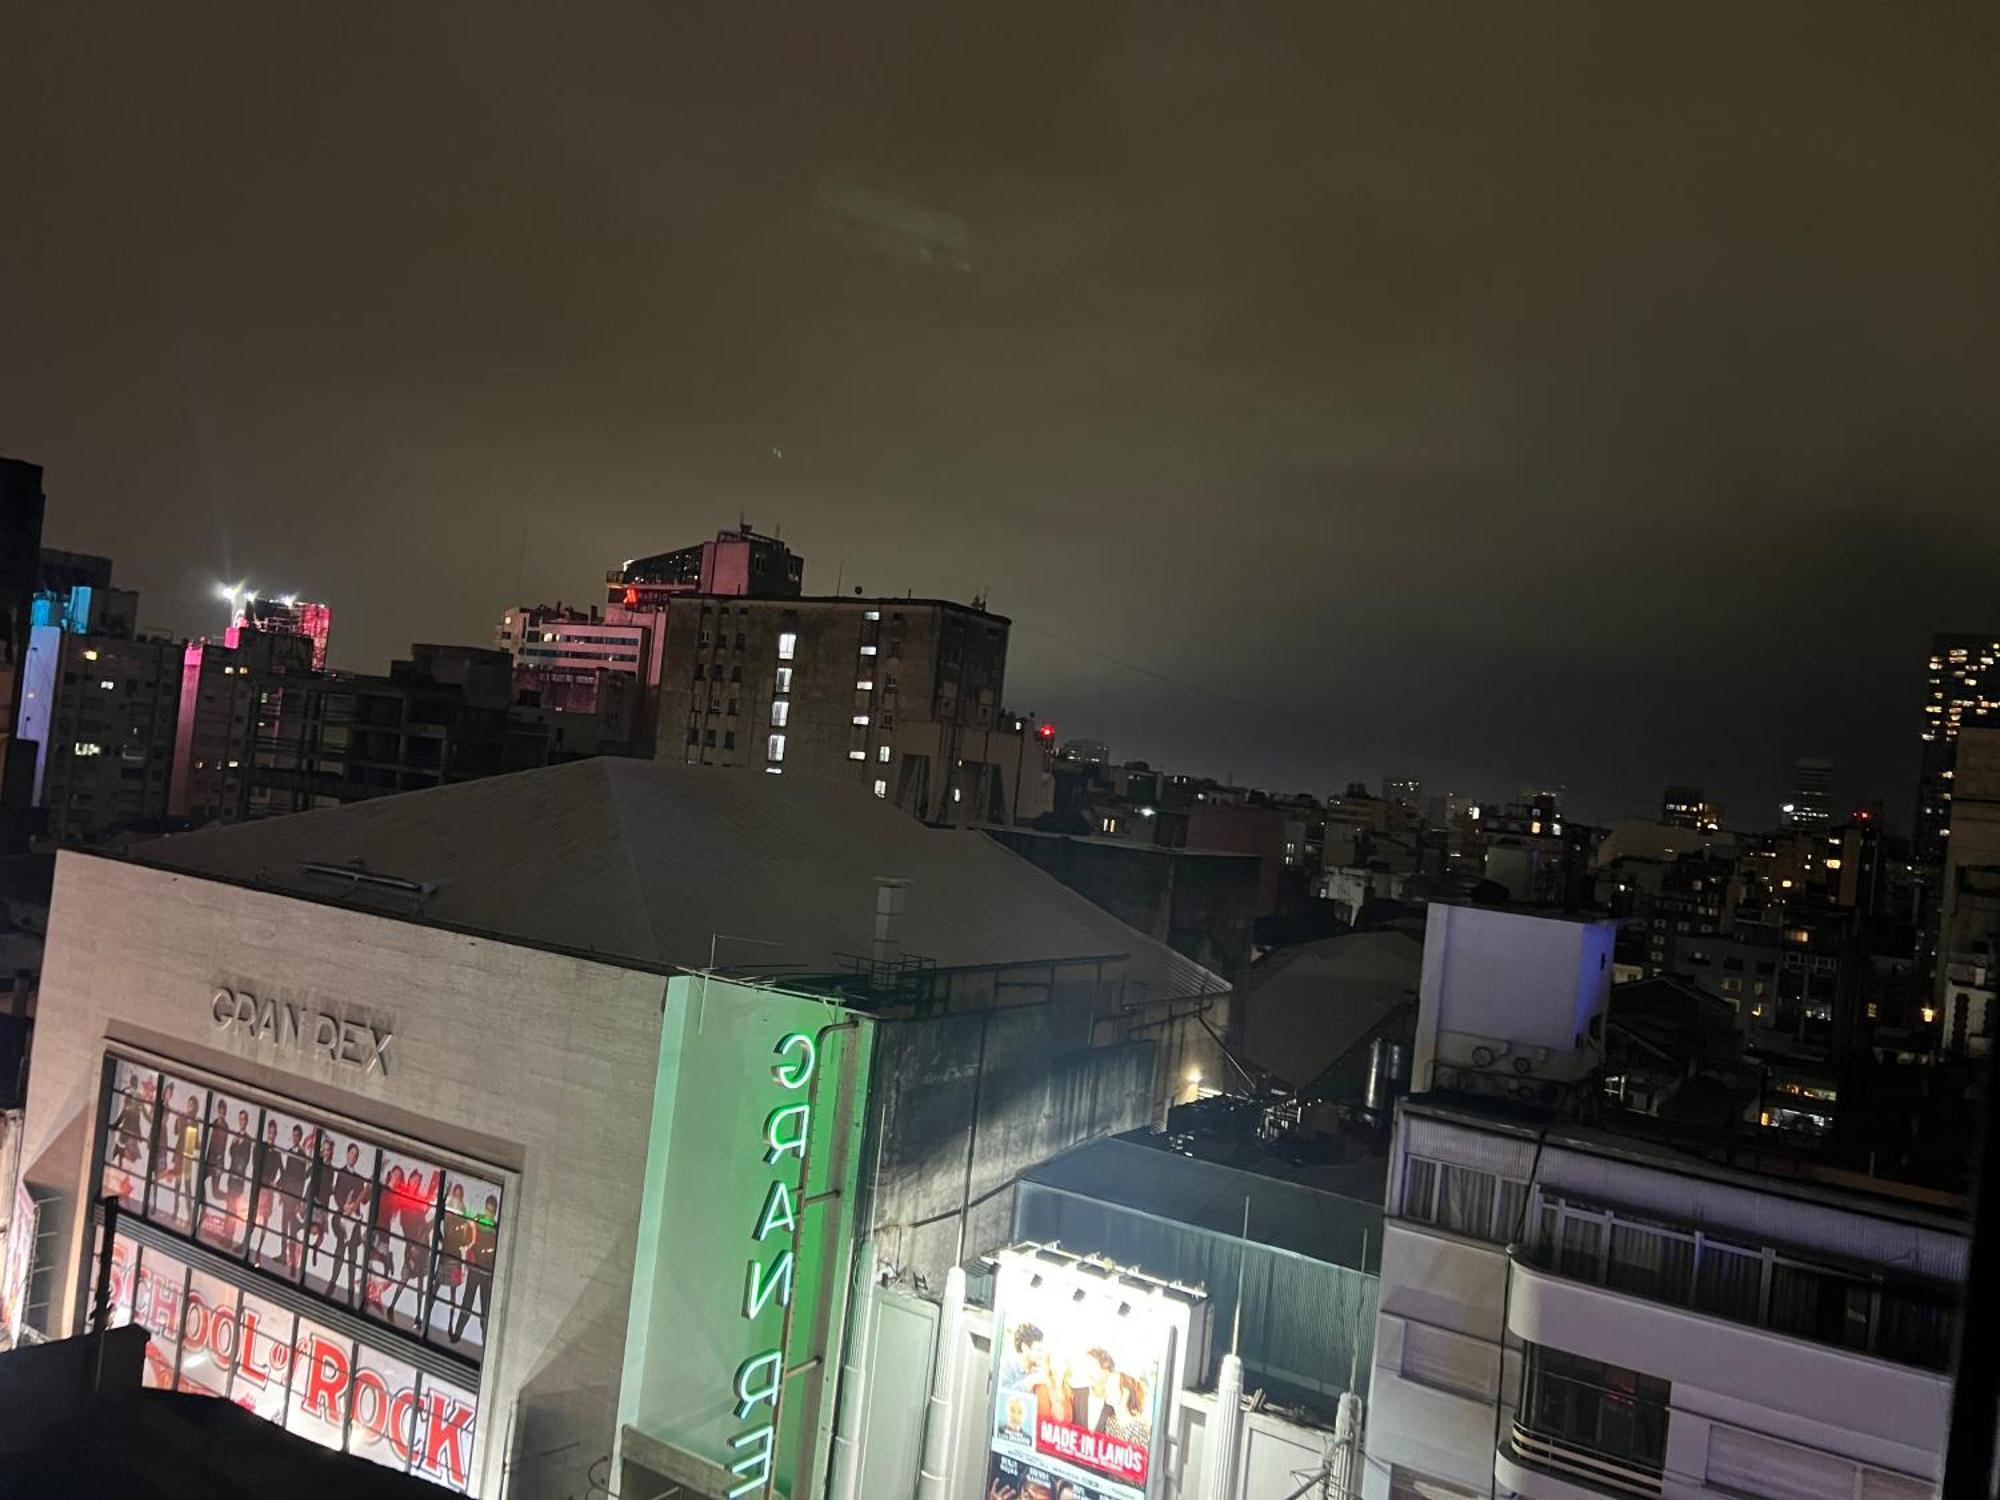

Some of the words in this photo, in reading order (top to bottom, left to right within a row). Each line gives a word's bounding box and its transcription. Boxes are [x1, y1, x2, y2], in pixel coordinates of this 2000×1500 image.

[212, 986, 307, 1054] GRAN
[313, 1013, 393, 1076] REX
[301, 1332, 475, 1494] ROCK
[1040, 1421, 1078, 1451] MADE
[1080, 1433, 1096, 1458] IN
[1097, 1438, 1143, 1473] LANÚS
